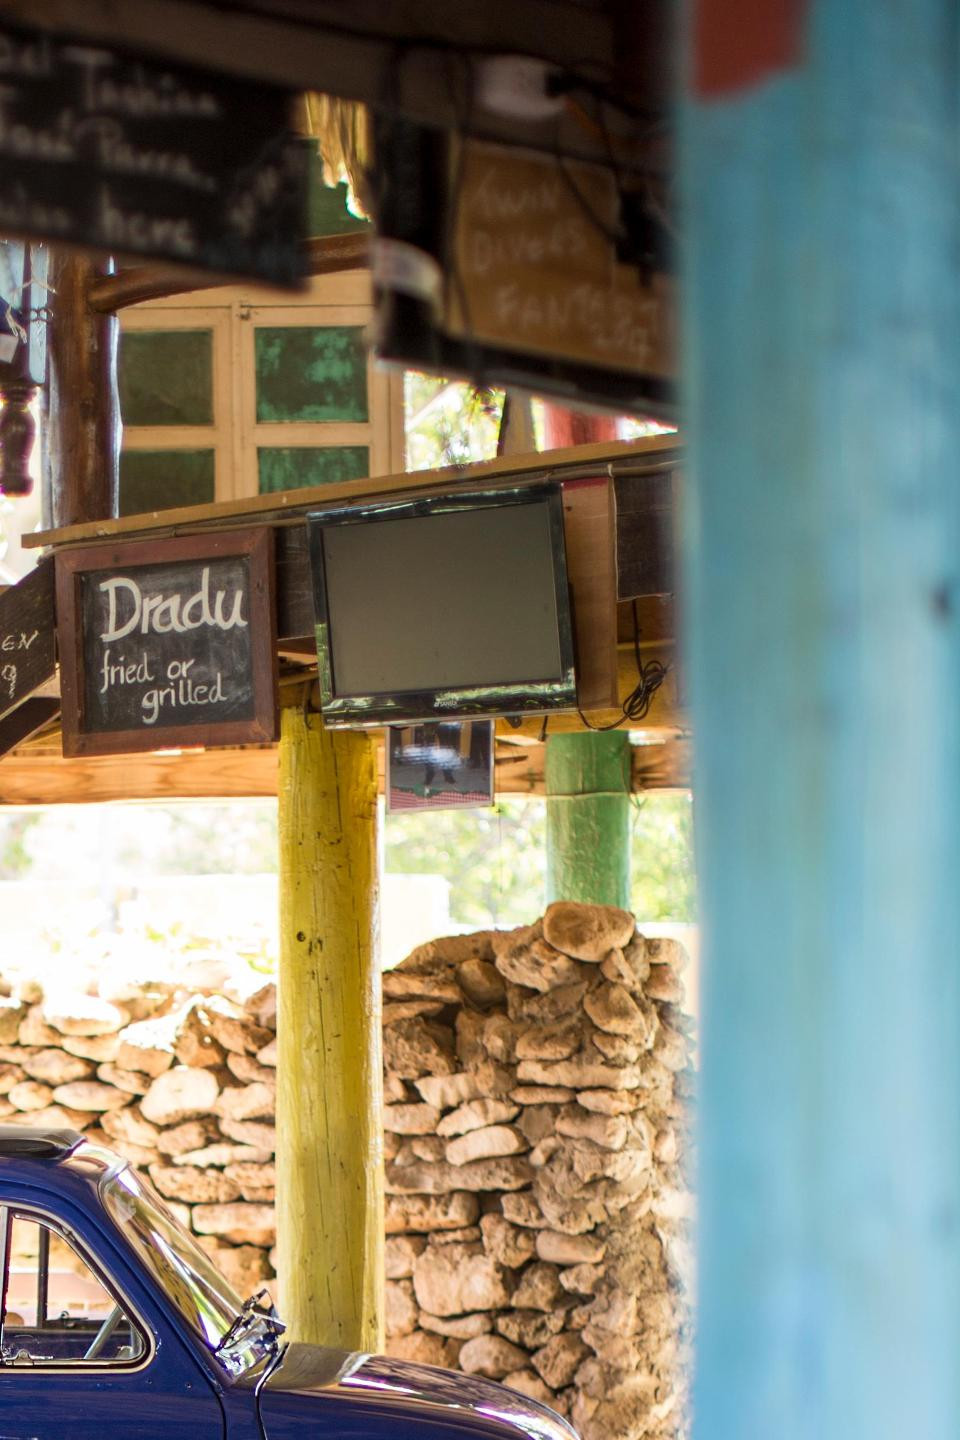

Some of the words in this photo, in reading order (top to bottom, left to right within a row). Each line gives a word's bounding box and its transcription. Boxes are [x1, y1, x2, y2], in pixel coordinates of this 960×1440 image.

[99, 567, 249, 642] Dradu
[99, 650, 155, 694] fried
[166, 658, 196, 680] or
[141, 672, 228, 725] grilled
